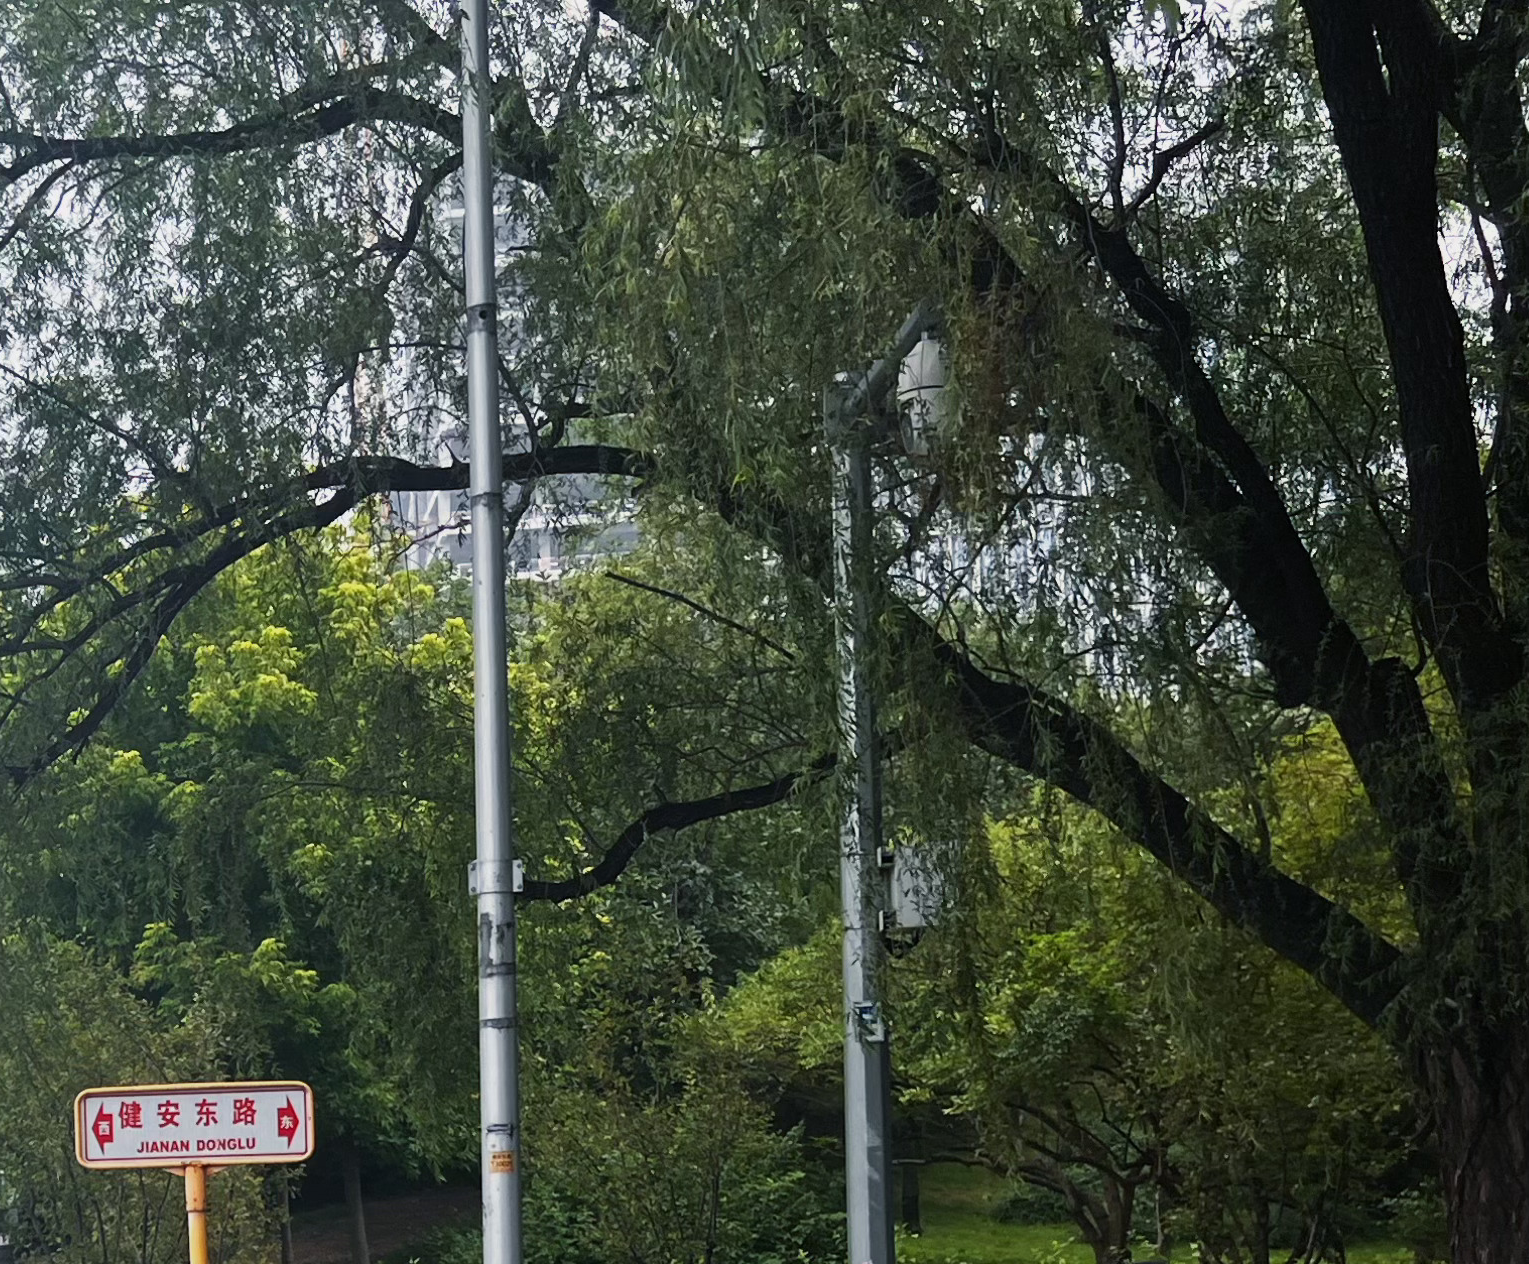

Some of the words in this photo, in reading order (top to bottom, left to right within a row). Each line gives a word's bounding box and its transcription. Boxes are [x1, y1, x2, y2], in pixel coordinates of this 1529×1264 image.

[118, 1097, 258, 1130] 健安东路
[279, 1116, 294, 1130] 东
[137, 1140, 190, 1154] JIANAN
[196, 1137, 257, 1151] DONGLU
